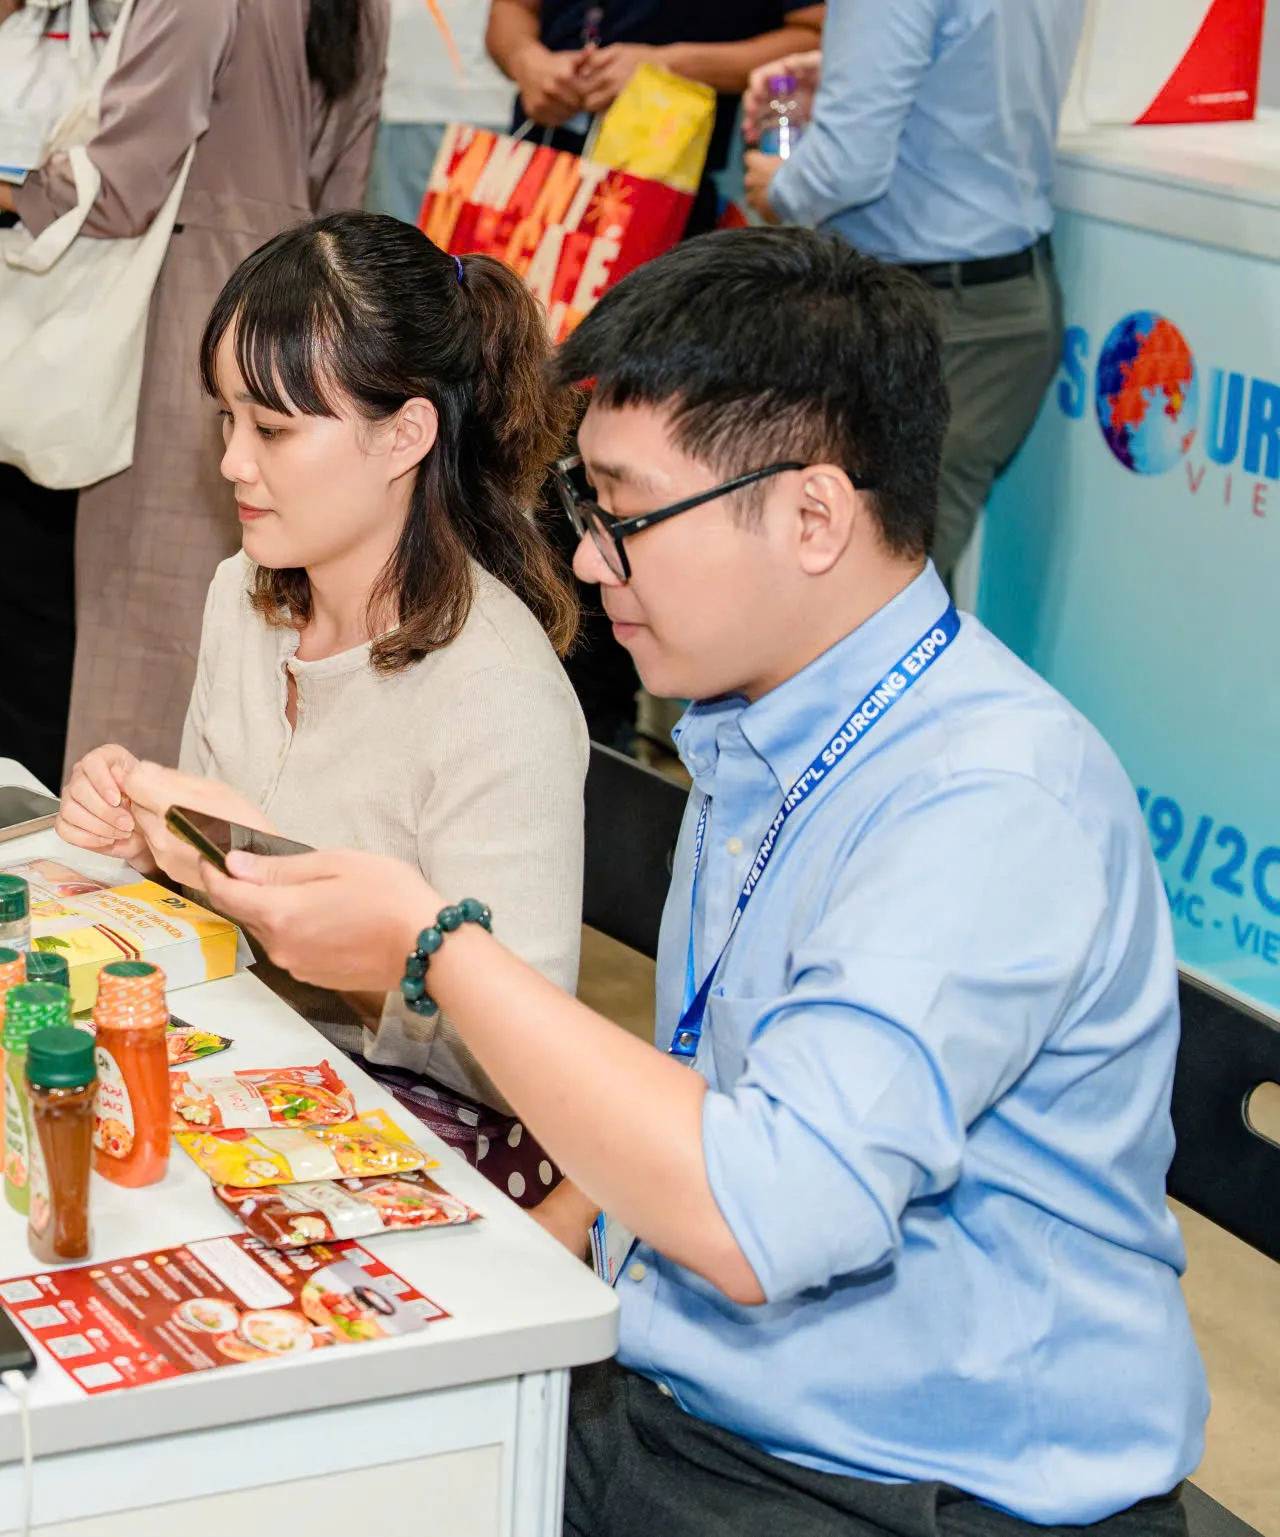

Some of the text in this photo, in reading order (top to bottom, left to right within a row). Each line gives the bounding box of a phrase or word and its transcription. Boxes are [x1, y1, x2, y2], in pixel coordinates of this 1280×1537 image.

[743, 627, 947, 896] VIETNAM INT'L SOURCING EXPO
